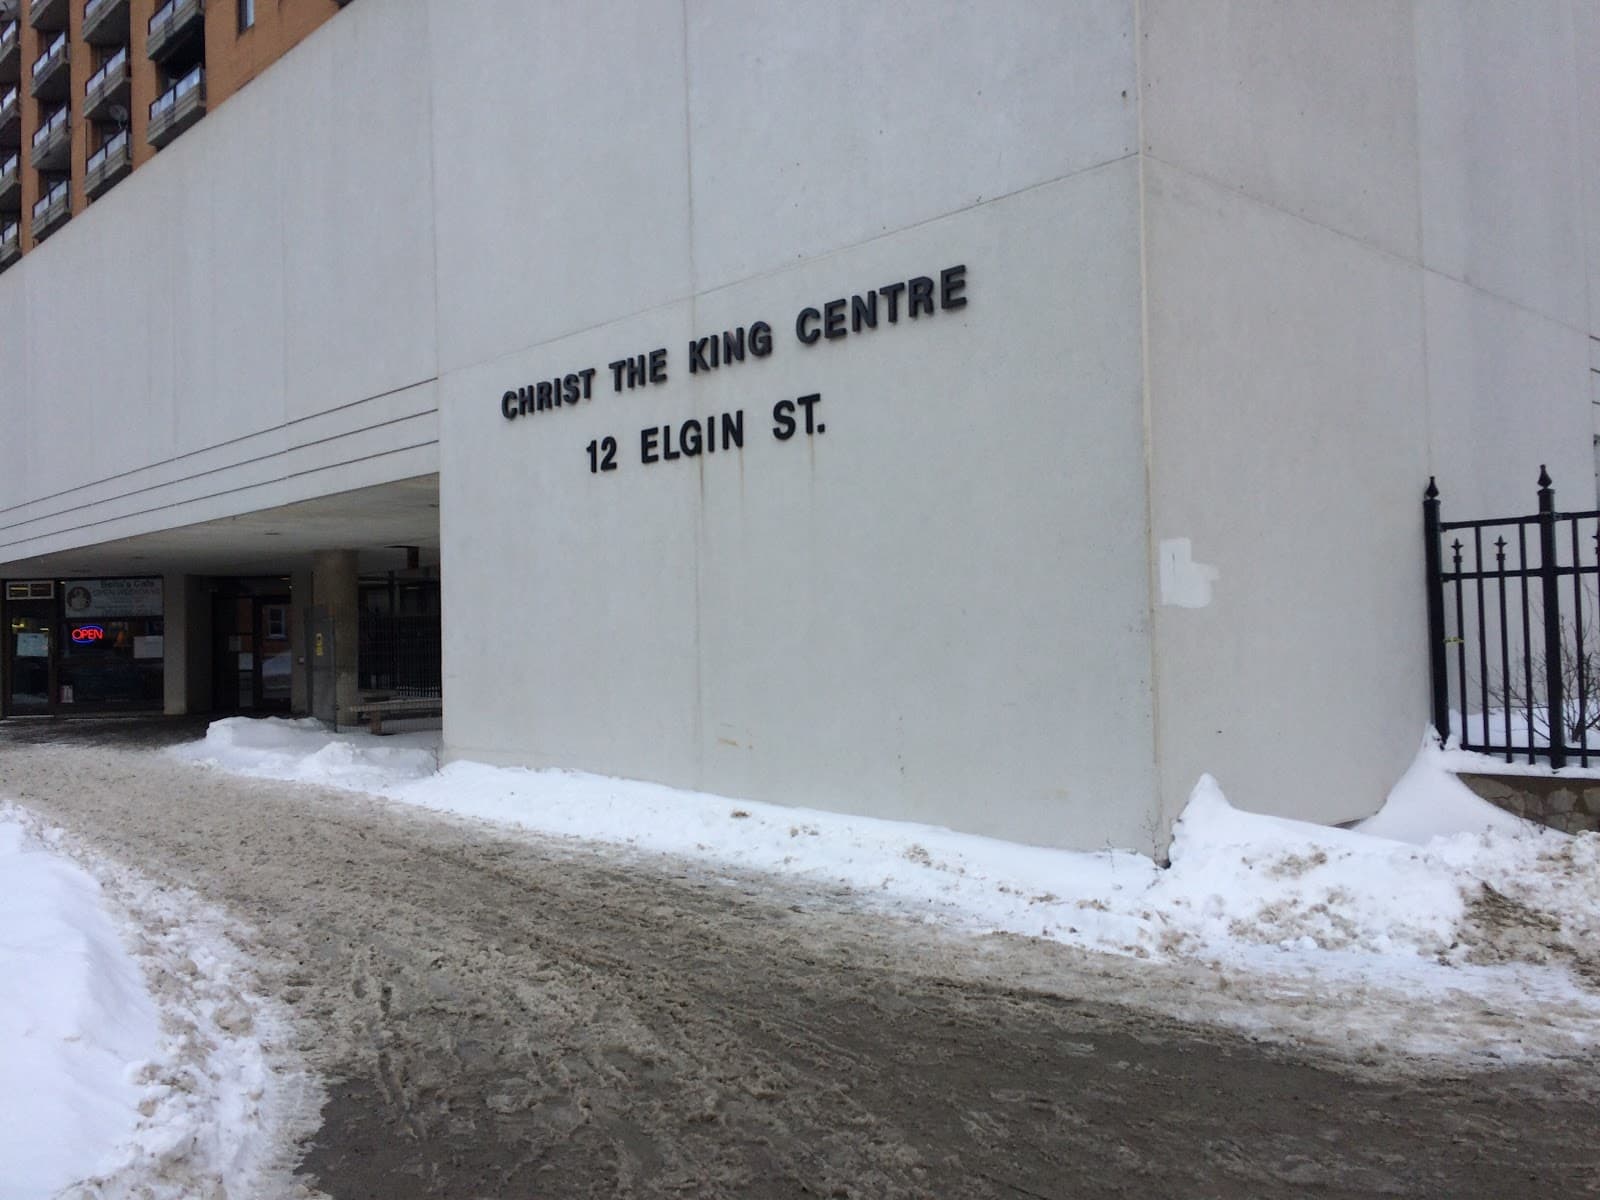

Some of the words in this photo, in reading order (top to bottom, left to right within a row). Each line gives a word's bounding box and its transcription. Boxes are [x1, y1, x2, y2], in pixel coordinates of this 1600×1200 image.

[501, 367, 596, 421] CHRIST
[608, 347, 668, 393] THE
[688, 320, 774, 375] KING
[795, 264, 968, 346] CENTRE
[585, 435, 618, 474] 12
[640, 409, 744, 465] ELGIN
[772, 392, 826, 441] ST.
[72, 629, 103, 640] OPEN
